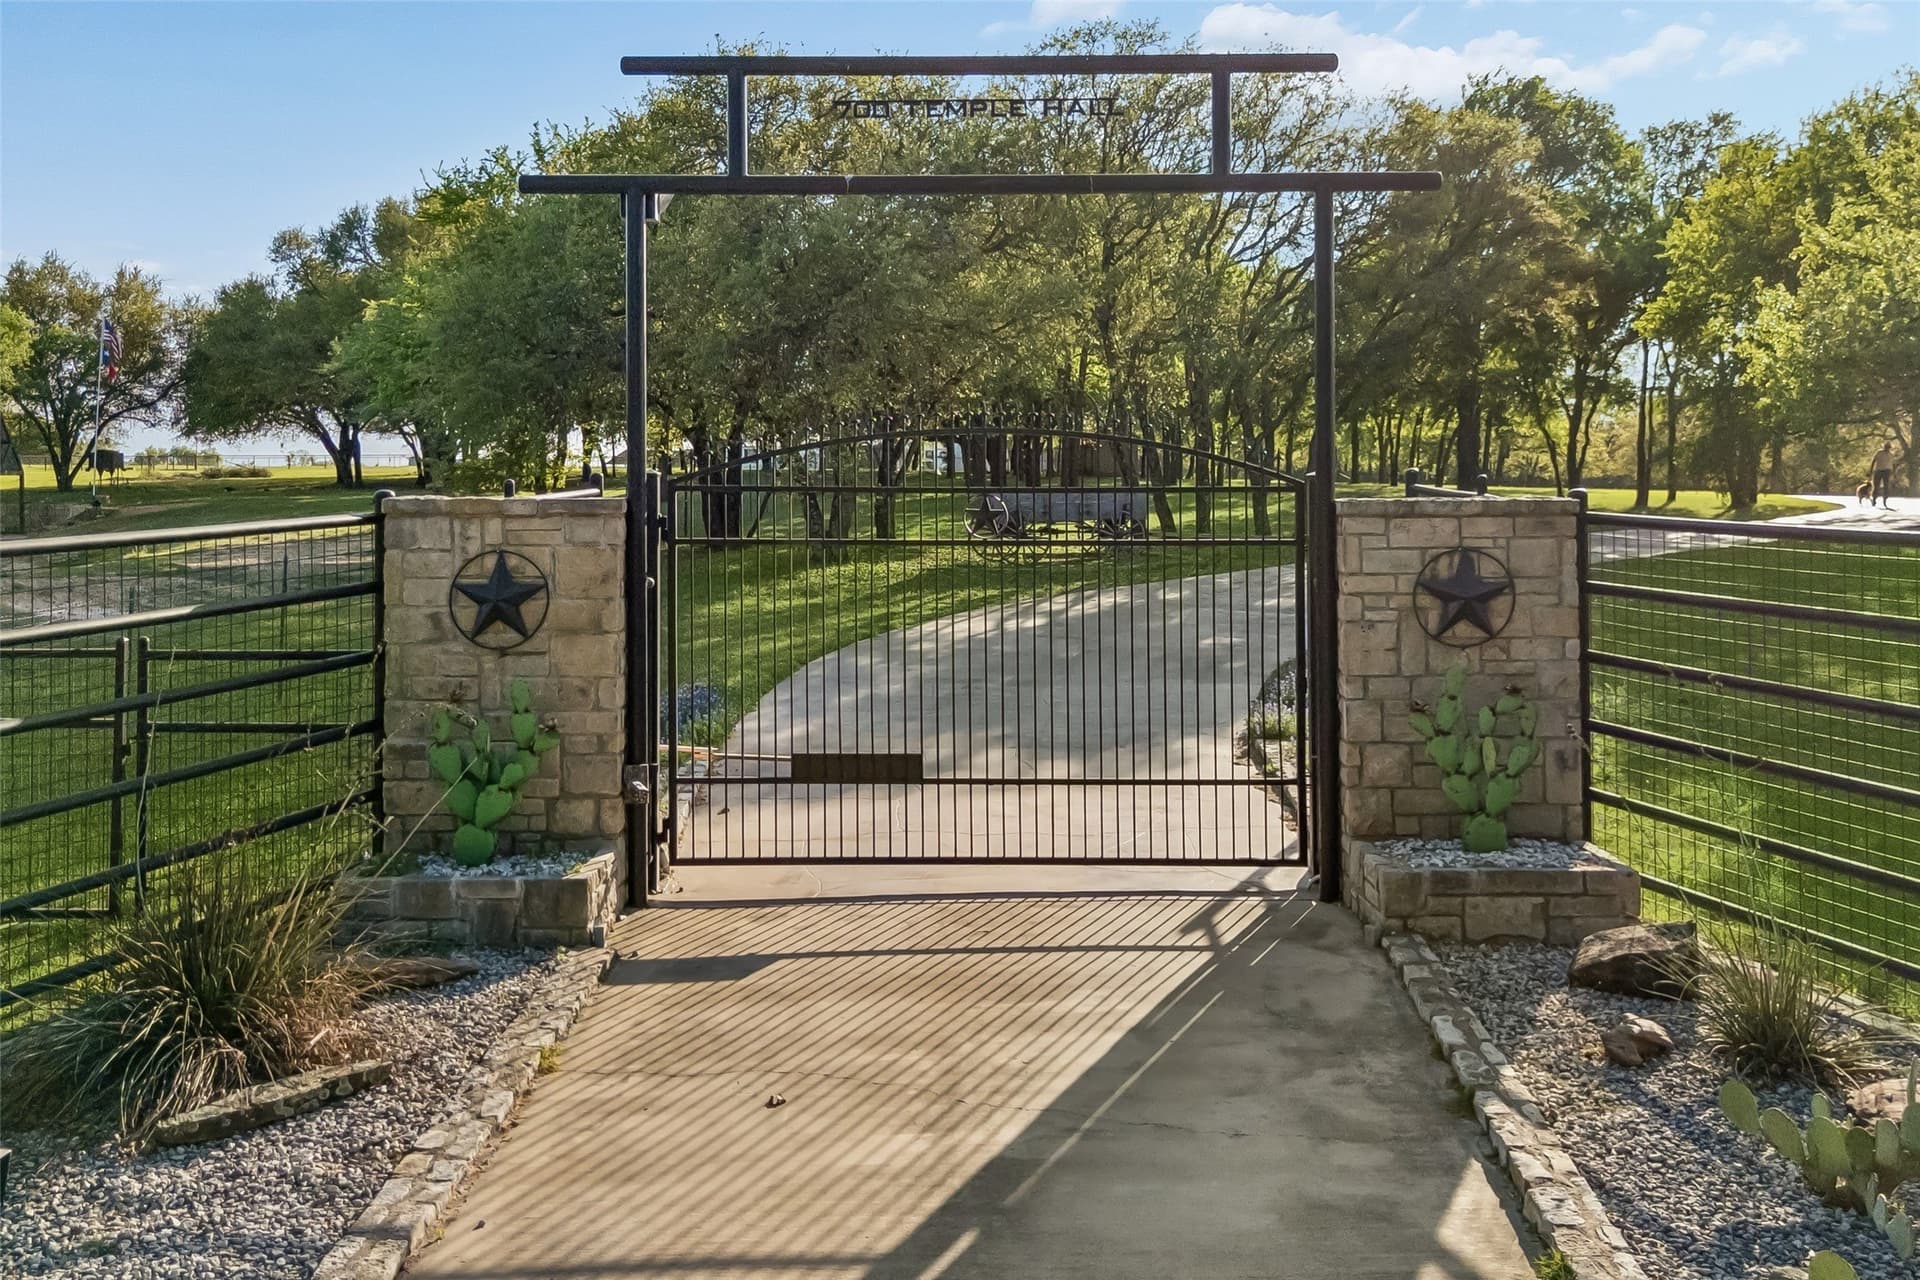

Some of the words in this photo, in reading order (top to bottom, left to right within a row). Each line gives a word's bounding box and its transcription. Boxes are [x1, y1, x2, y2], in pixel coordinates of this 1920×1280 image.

[833, 100, 889, 118] 700
[903, 99, 1026, 117] TEMPLE
[1043, 98, 1124, 116] HALL
